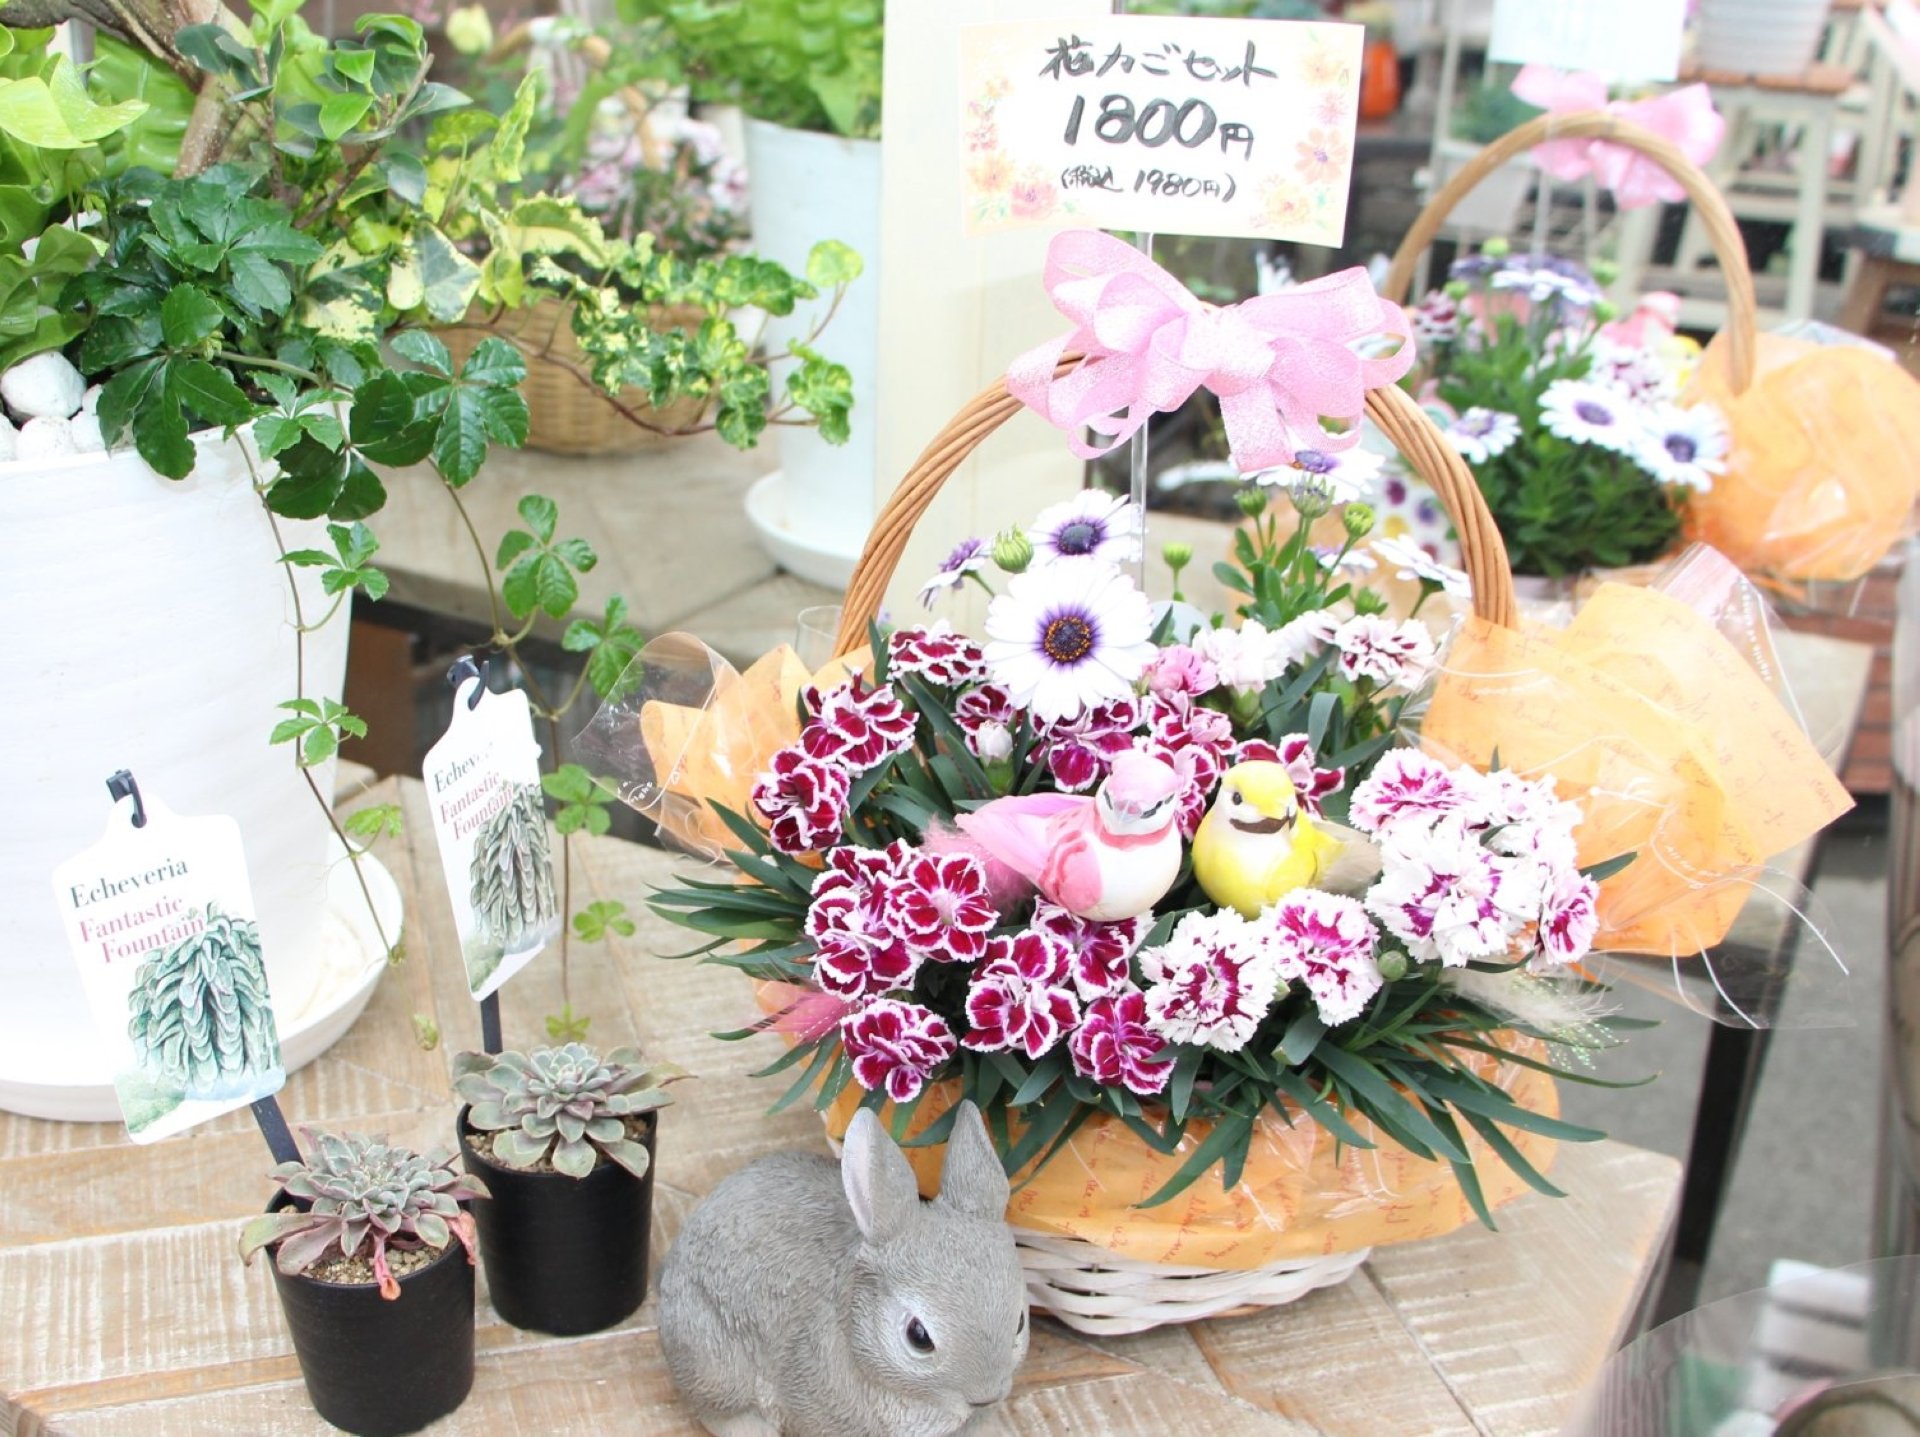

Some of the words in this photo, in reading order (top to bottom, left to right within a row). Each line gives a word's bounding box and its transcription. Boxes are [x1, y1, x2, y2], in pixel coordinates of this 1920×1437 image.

[1063, 94, 1254, 160] 1800円
[439, 771, 500, 825] Fantastic
[453, 787, 514, 840] Fountain
[69, 857, 189, 909] Echeveria
[79, 895, 183, 943] Fantastic
[101, 916, 205, 963] Fountain
